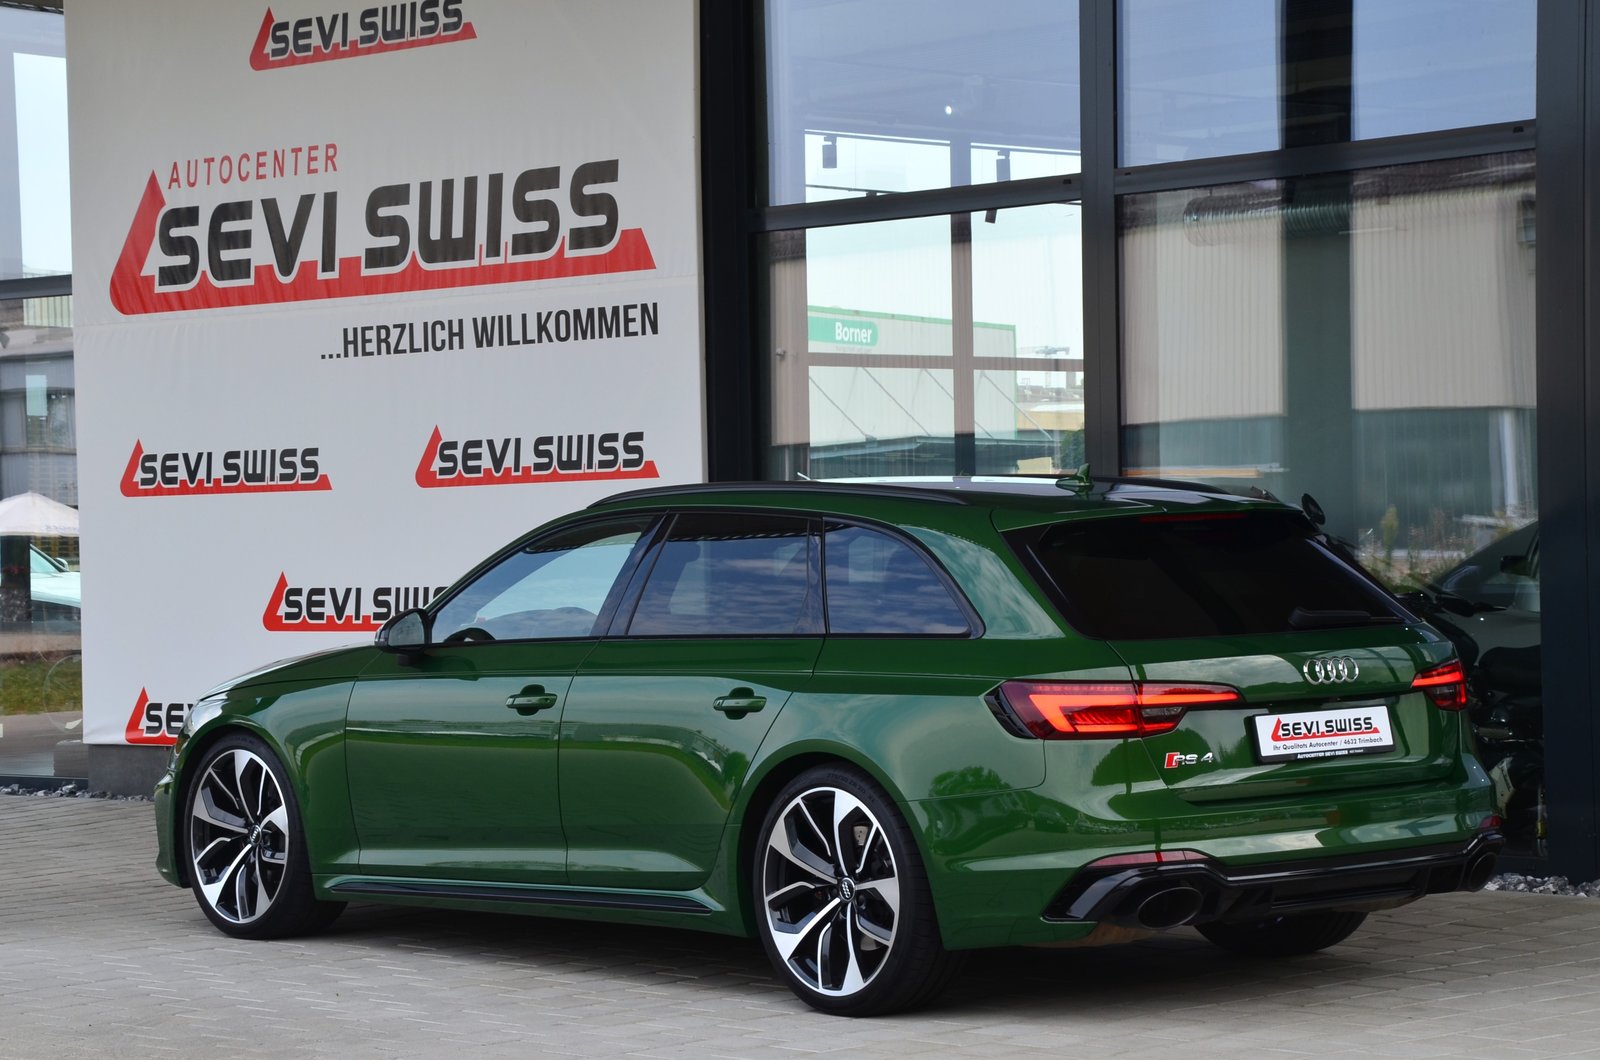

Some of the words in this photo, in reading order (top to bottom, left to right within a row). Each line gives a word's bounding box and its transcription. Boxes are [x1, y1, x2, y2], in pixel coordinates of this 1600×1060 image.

[271, 12, 348, 58] SEVI
[359, 0, 463, 45] SWISS
[167, 143, 338, 190] AUTOCENTER
[158, 191, 338, 287] SEVI
[365, 159, 619, 270] SWISS
[472, 302, 659, 349] WILLKOMMEN
[835, 321, 872, 344] Borner
[140, 451, 213, 487] SEVI
[222, 447, 319, 485] SWISS
[438, 437, 521, 477] SEVI
[533, 431, 644, 474] SWISS
[284, 587, 362, 621] SEVI
[371, 586, 448, 621] SWI
[145, 702, 193, 735] SE
[1281, 721, 1319, 737] SEVI
[1325, 717, 1372, 733] SWISS
[1169, 753, 1198, 766] RS
[1201, 752, 1213, 763] 4
[1309, 738, 1338, 747] Autocenter
